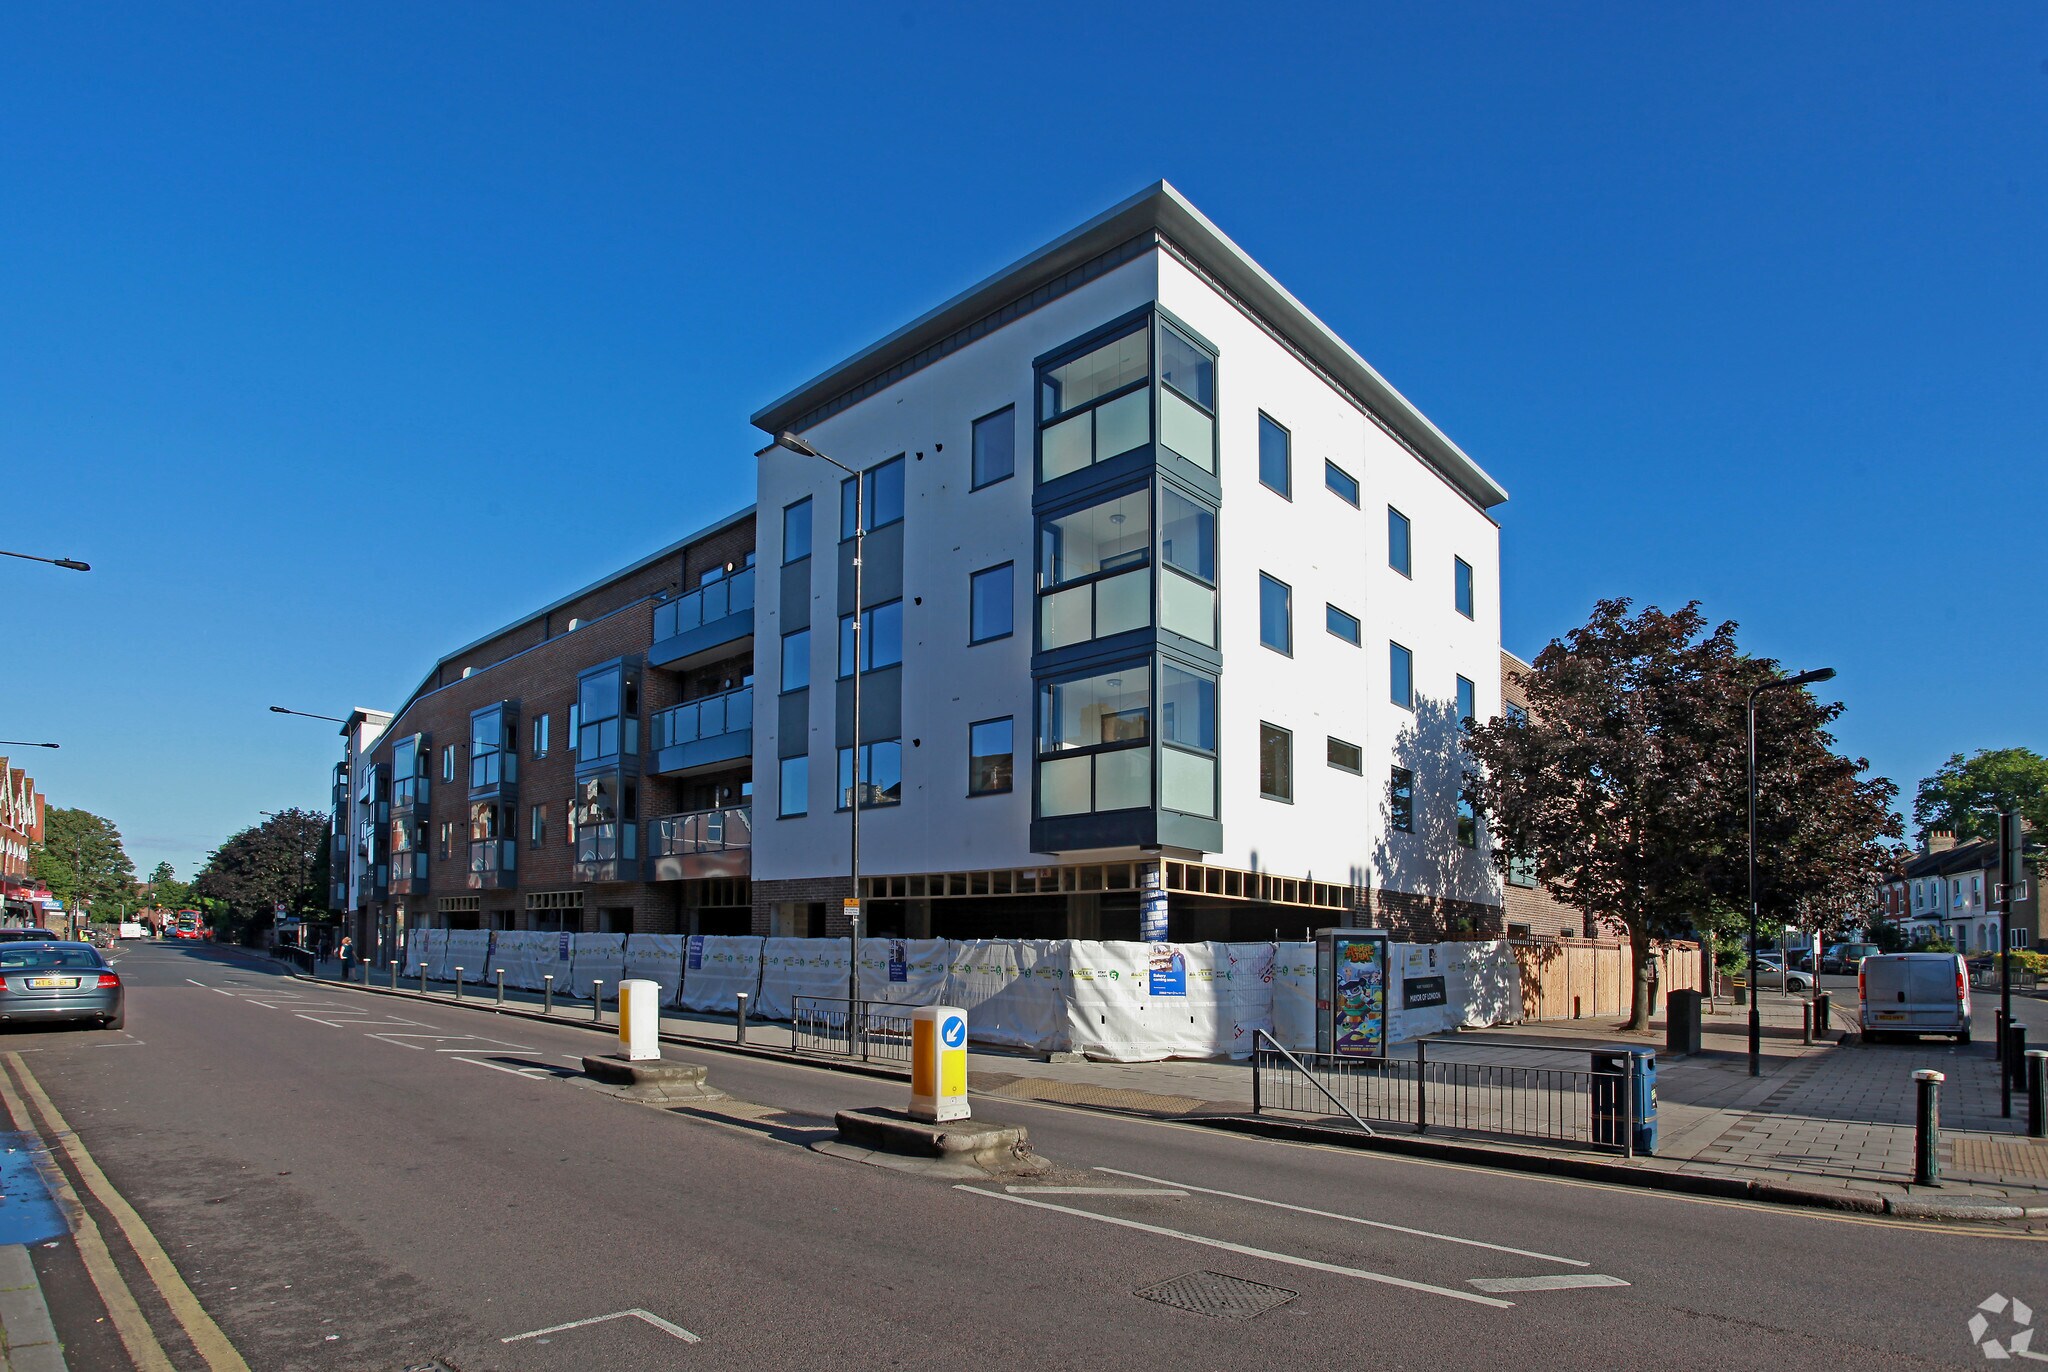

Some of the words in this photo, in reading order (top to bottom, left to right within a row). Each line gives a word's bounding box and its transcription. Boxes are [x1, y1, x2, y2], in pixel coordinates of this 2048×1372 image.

[1409, 993, 1422, 1003] MAYOR
[1422, 993, 1427, 1001] OF
[1427, 991, 1441, 1001] LONDON
